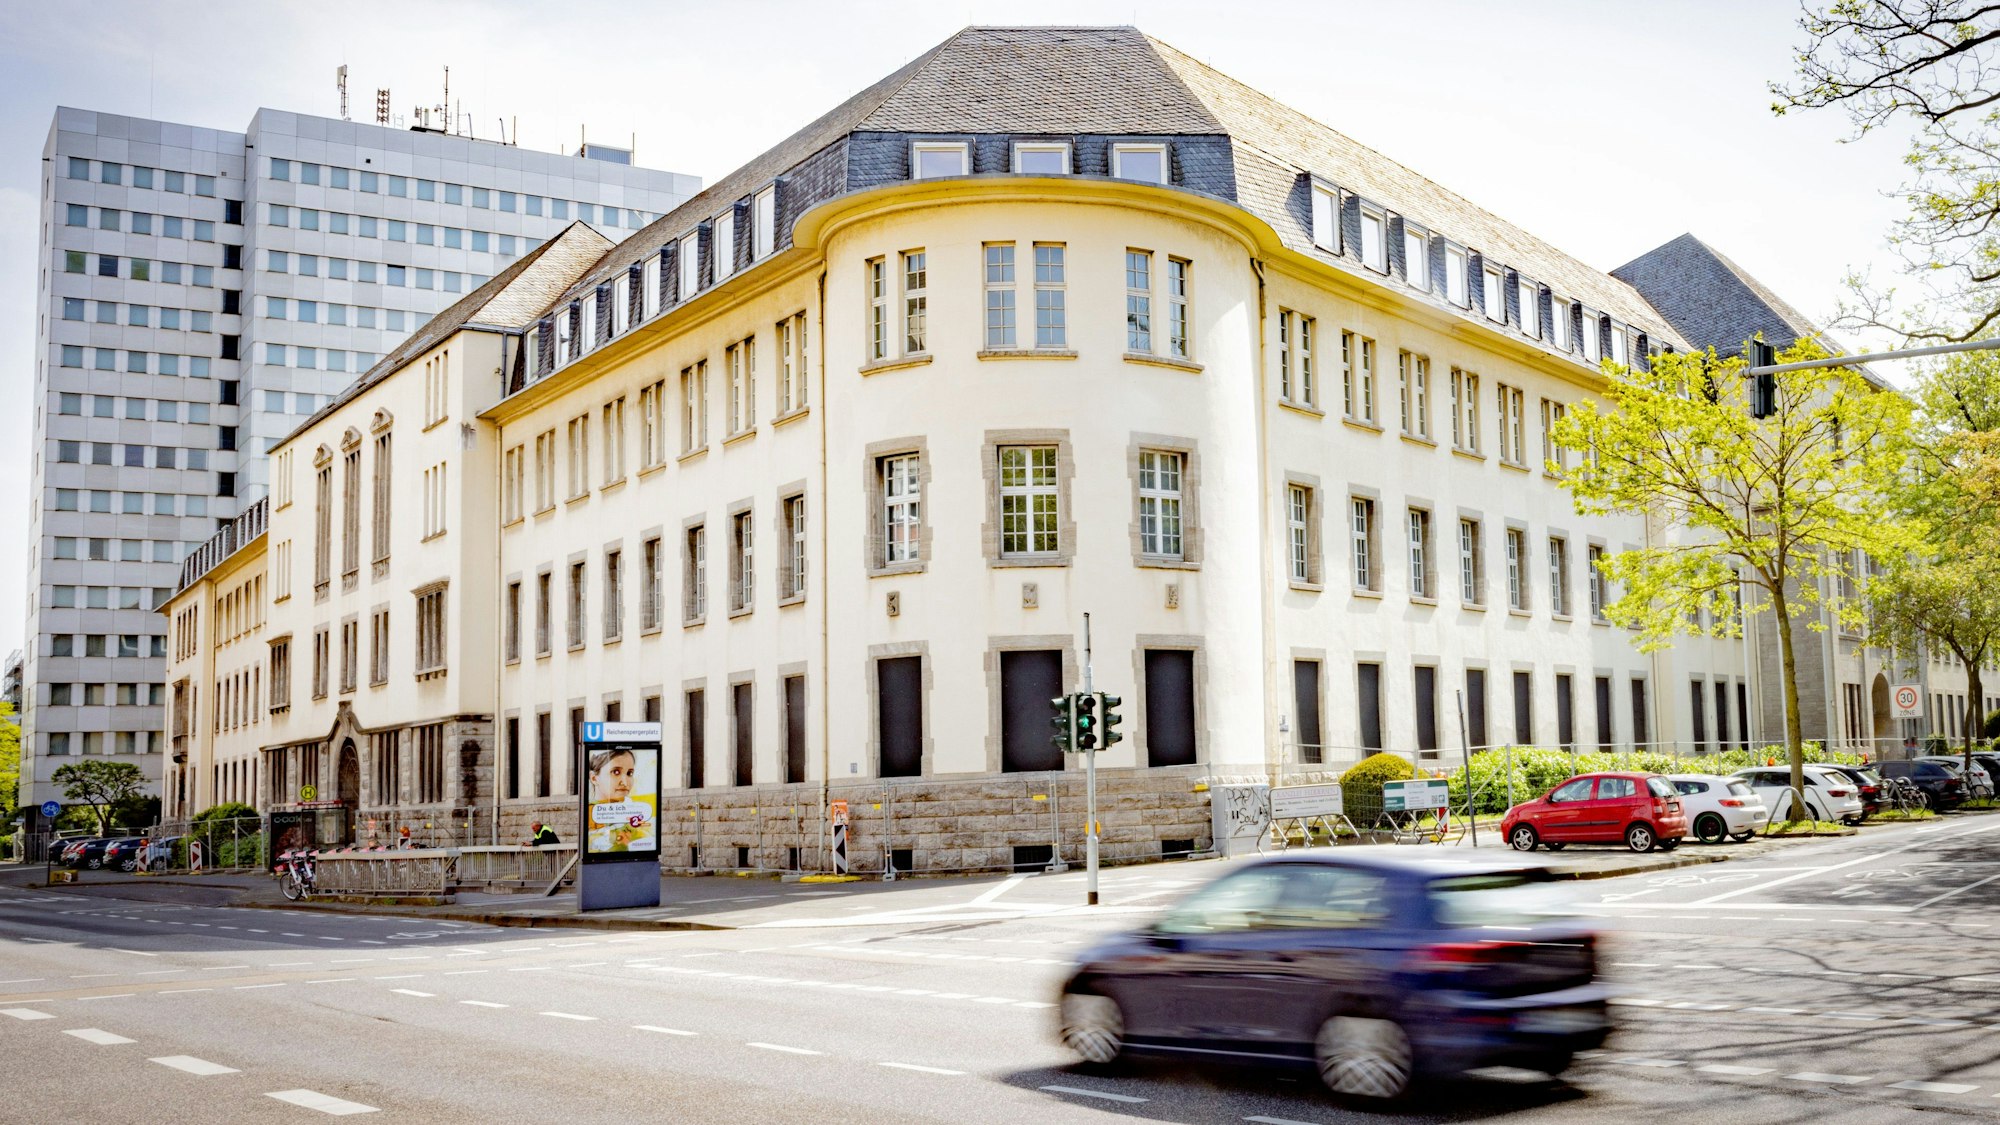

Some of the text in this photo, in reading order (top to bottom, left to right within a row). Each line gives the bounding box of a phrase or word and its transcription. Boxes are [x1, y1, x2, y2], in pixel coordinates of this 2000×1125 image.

[1900, 693, 1913, 703] 30
[587, 724, 659, 740] U Reichenspergerplatz
